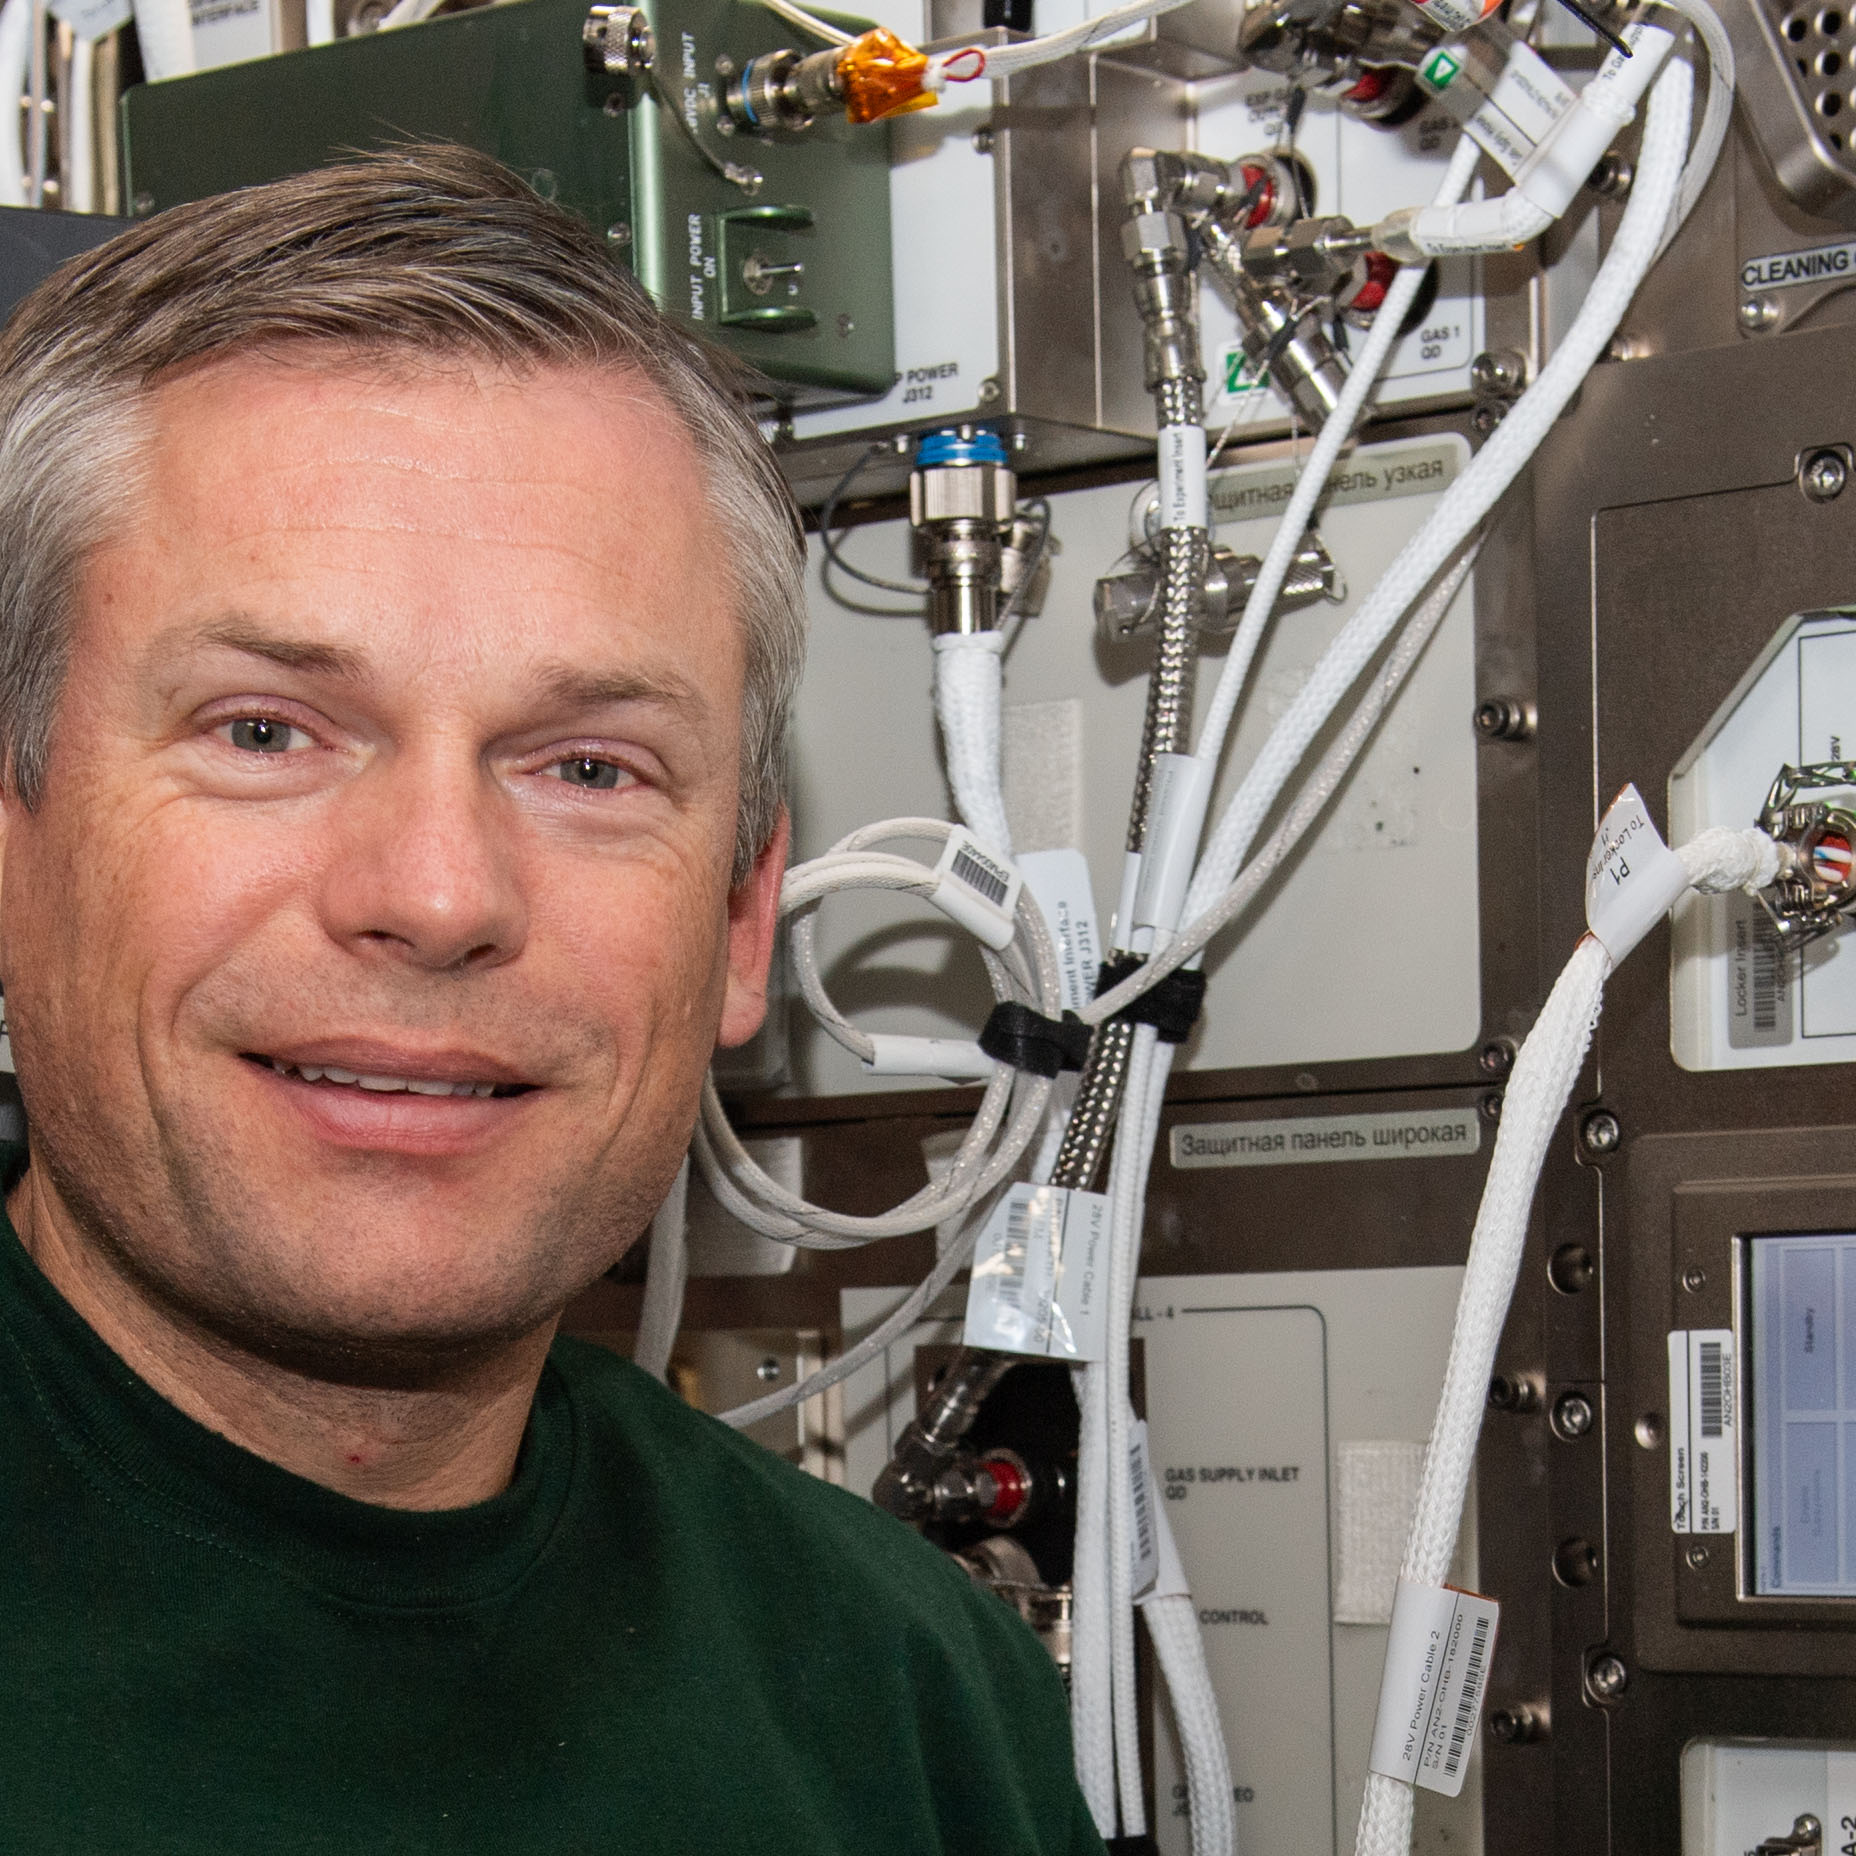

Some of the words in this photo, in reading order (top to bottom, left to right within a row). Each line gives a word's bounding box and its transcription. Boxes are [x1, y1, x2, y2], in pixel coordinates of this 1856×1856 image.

[682, 32, 695, 78] INPUT
[688, 214, 702, 266] POWER
[703, 257, 716, 278] ON
[1744, 250, 1848, 286] CLEANING
[690, 274, 704, 320] INPUT
[1421, 327, 1450, 343] GAS
[907, 362, 958, 383] POWER
[903, 385, 933, 403] J312
[1385, 460, 1443, 491] узкая
[1630, 815, 1644, 831] To
[1610, 857, 1631, 886] P1
[1075, 921, 1092, 954] J312
[1735, 920, 1747, 963] Insert
[1735, 967, 1747, 1016] Locker
[1181, 1133, 1285, 1158] Защитная
[1291, 1128, 1366, 1151] панель
[1373, 1124, 1467, 1150] широкая
[1091, 1204, 1103, 1229] 28V
[1087, 1231, 1099, 1267] Power
[1082, 1272, 1094, 1305] Cable
[1165, 1468, 1195, 1482] GAS
[1199, 1468, 1255, 1482] SUPPLY
[1258, 1466, 1299, 1482] INLET
[1676, 1447, 1686, 1489] Screen
[1199, 1610, 1269, 1625] CONTROL
[1403, 1733, 1416, 1761] 28V
[1410, 1687, 1426, 1730] Power
[1421, 1644, 1438, 1683] Cable
[1431, 1630, 1440, 1641] 2
[1423, 1742, 1435, 1767] P/N
[1432, 1744, 1443, 1769] S/N
[1439, 1724, 1448, 1740] 01
